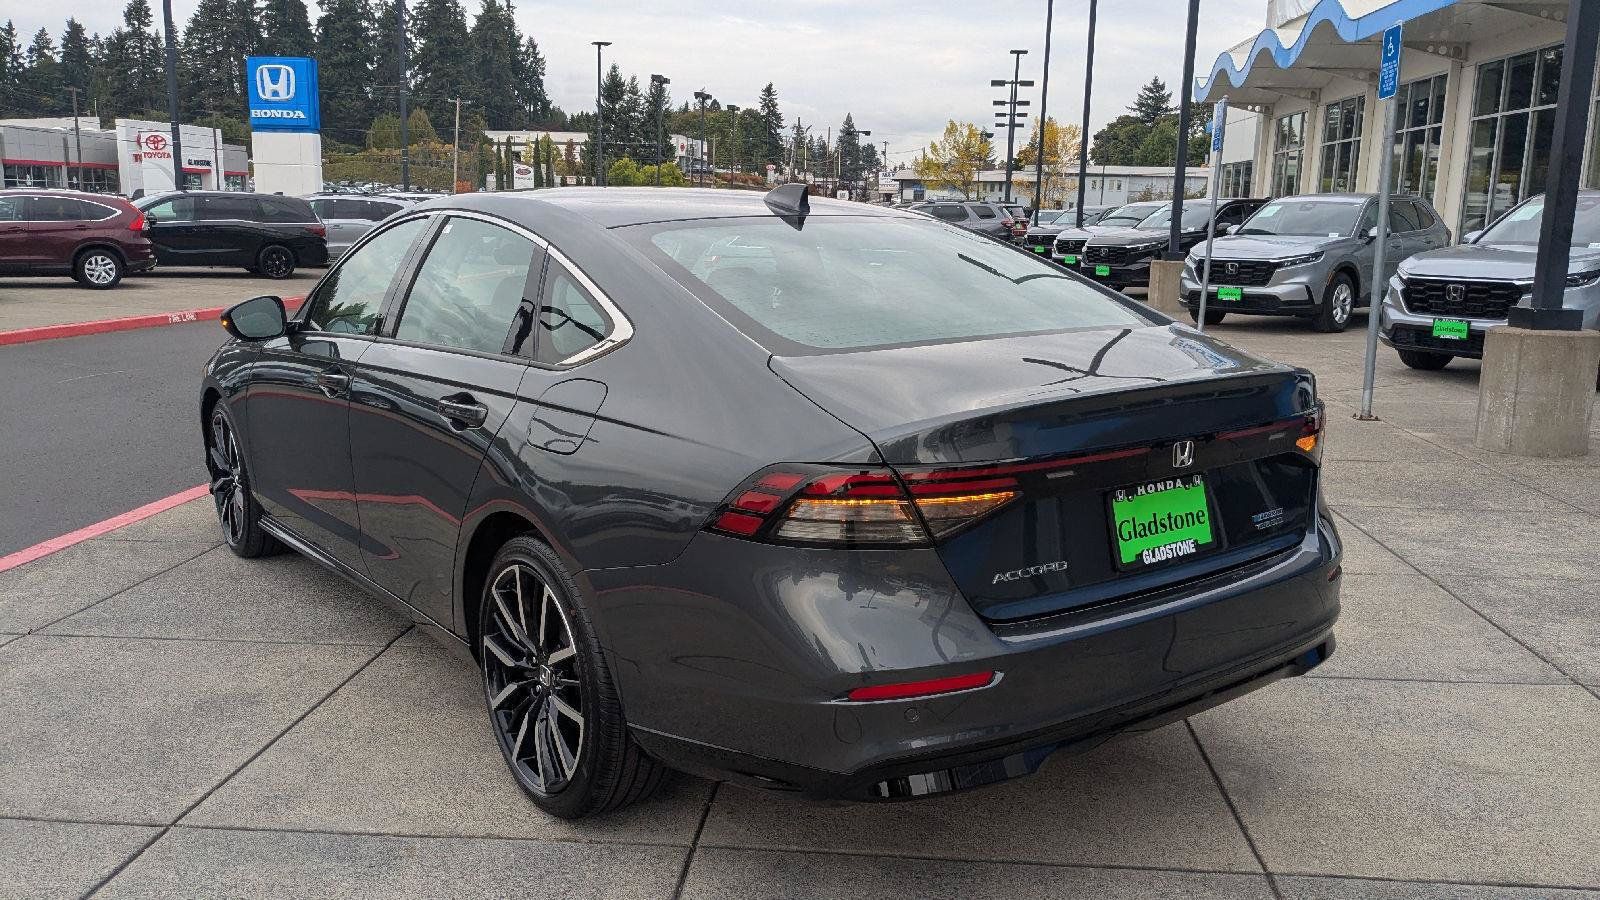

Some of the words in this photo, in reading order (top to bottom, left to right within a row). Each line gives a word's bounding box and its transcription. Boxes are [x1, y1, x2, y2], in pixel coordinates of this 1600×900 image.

[251, 109, 306, 118] HONDA
[142, 151, 172, 159] TOYOTA
[1137, 479, 1183, 495] HONDA
[1118, 509, 1206, 542] Gladstone
[1142, 539, 1197, 565] GLADSTONE
[991, 560, 1068, 585] ACCORD
